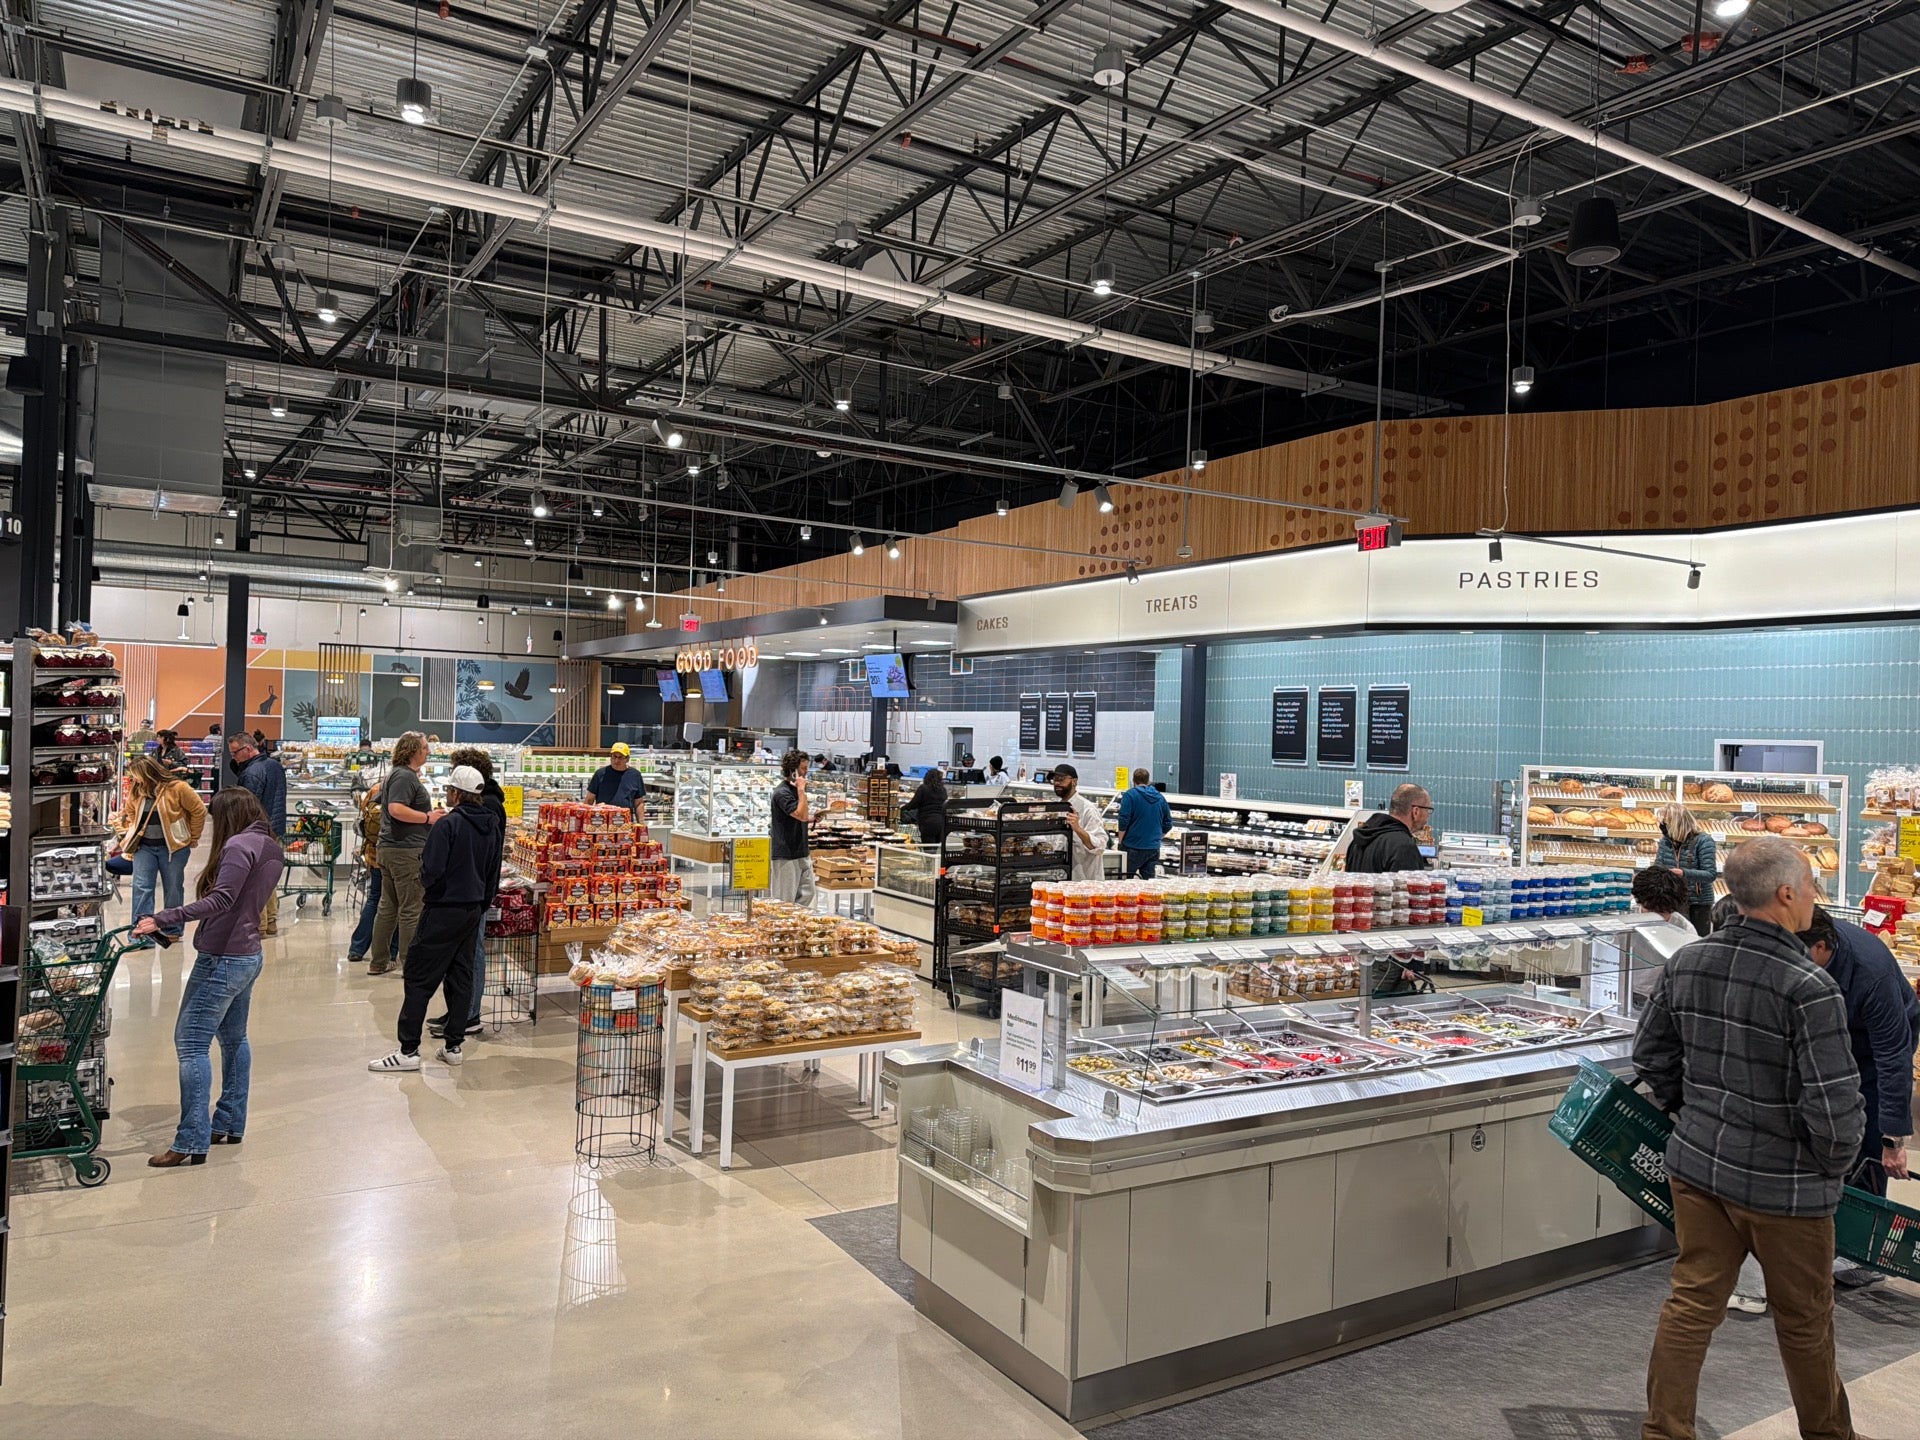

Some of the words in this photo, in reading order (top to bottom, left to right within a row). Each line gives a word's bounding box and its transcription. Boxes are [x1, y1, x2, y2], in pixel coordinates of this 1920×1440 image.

[6, 517, 22, 535] 10
[1363, 526, 1387, 550] EXIT
[1458, 569, 1600, 589] PASTRIES
[1146, 595, 1199, 613] TREATS
[976, 617, 1008, 632] CAKES
[676, 651, 713, 673] GOOD
[718, 646, 758, 670] FOOD
[815, 686, 856, 742] FOR
[1007, 1013, 1037, 1028] Mediterranean
[1629, 1163, 1657, 1184] MARKET
[1630, 1151, 1668, 1184] FOODS
